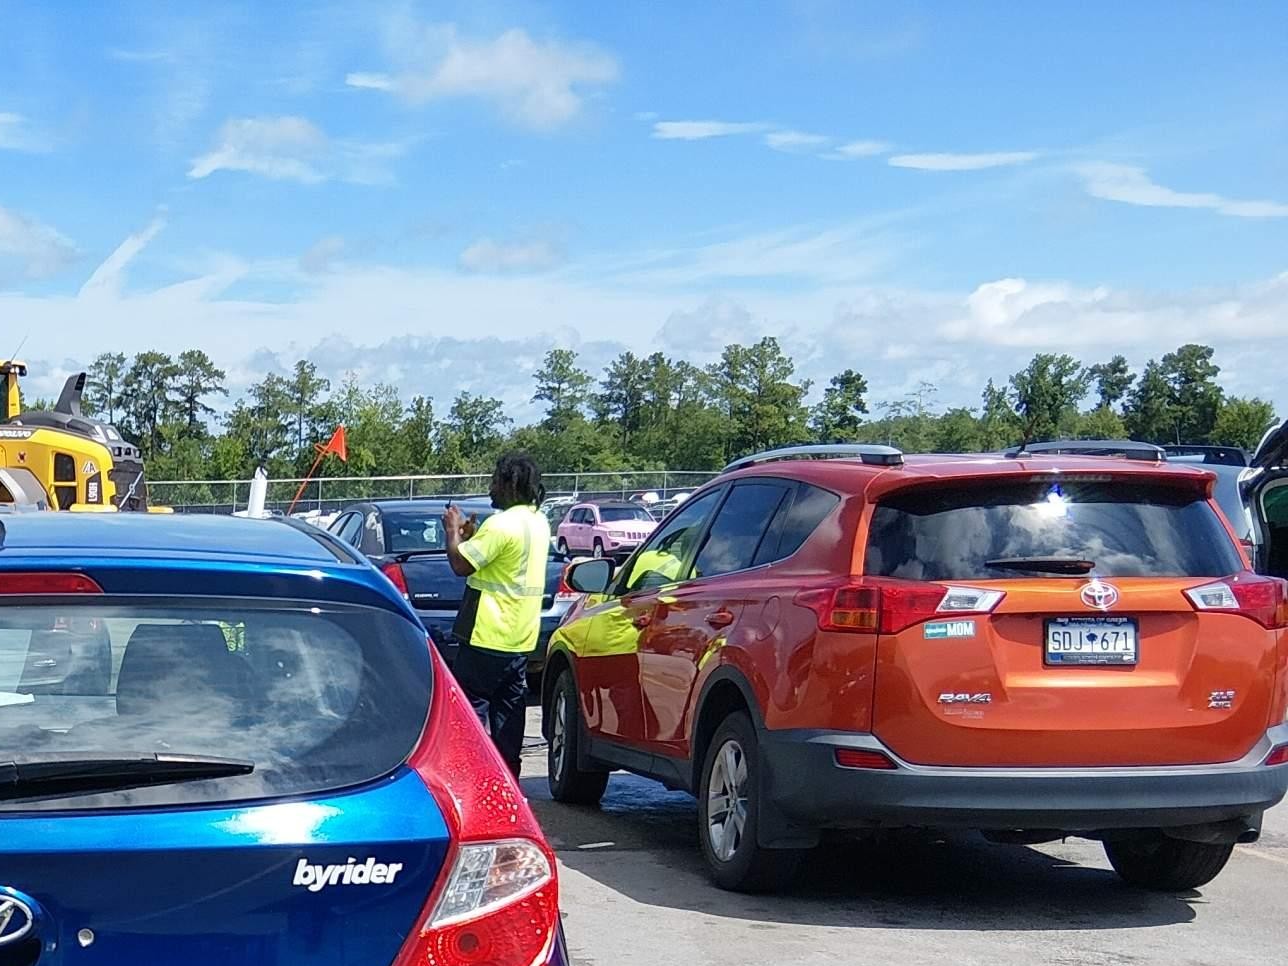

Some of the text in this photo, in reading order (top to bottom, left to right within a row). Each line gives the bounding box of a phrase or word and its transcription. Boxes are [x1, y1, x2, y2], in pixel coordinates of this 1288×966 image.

[946, 622, 974, 636] MOM
[1052, 631, 1131, 651] SDJ 671
[937, 693, 992, 704] RAV4
[292, 857, 403, 892] byrider
